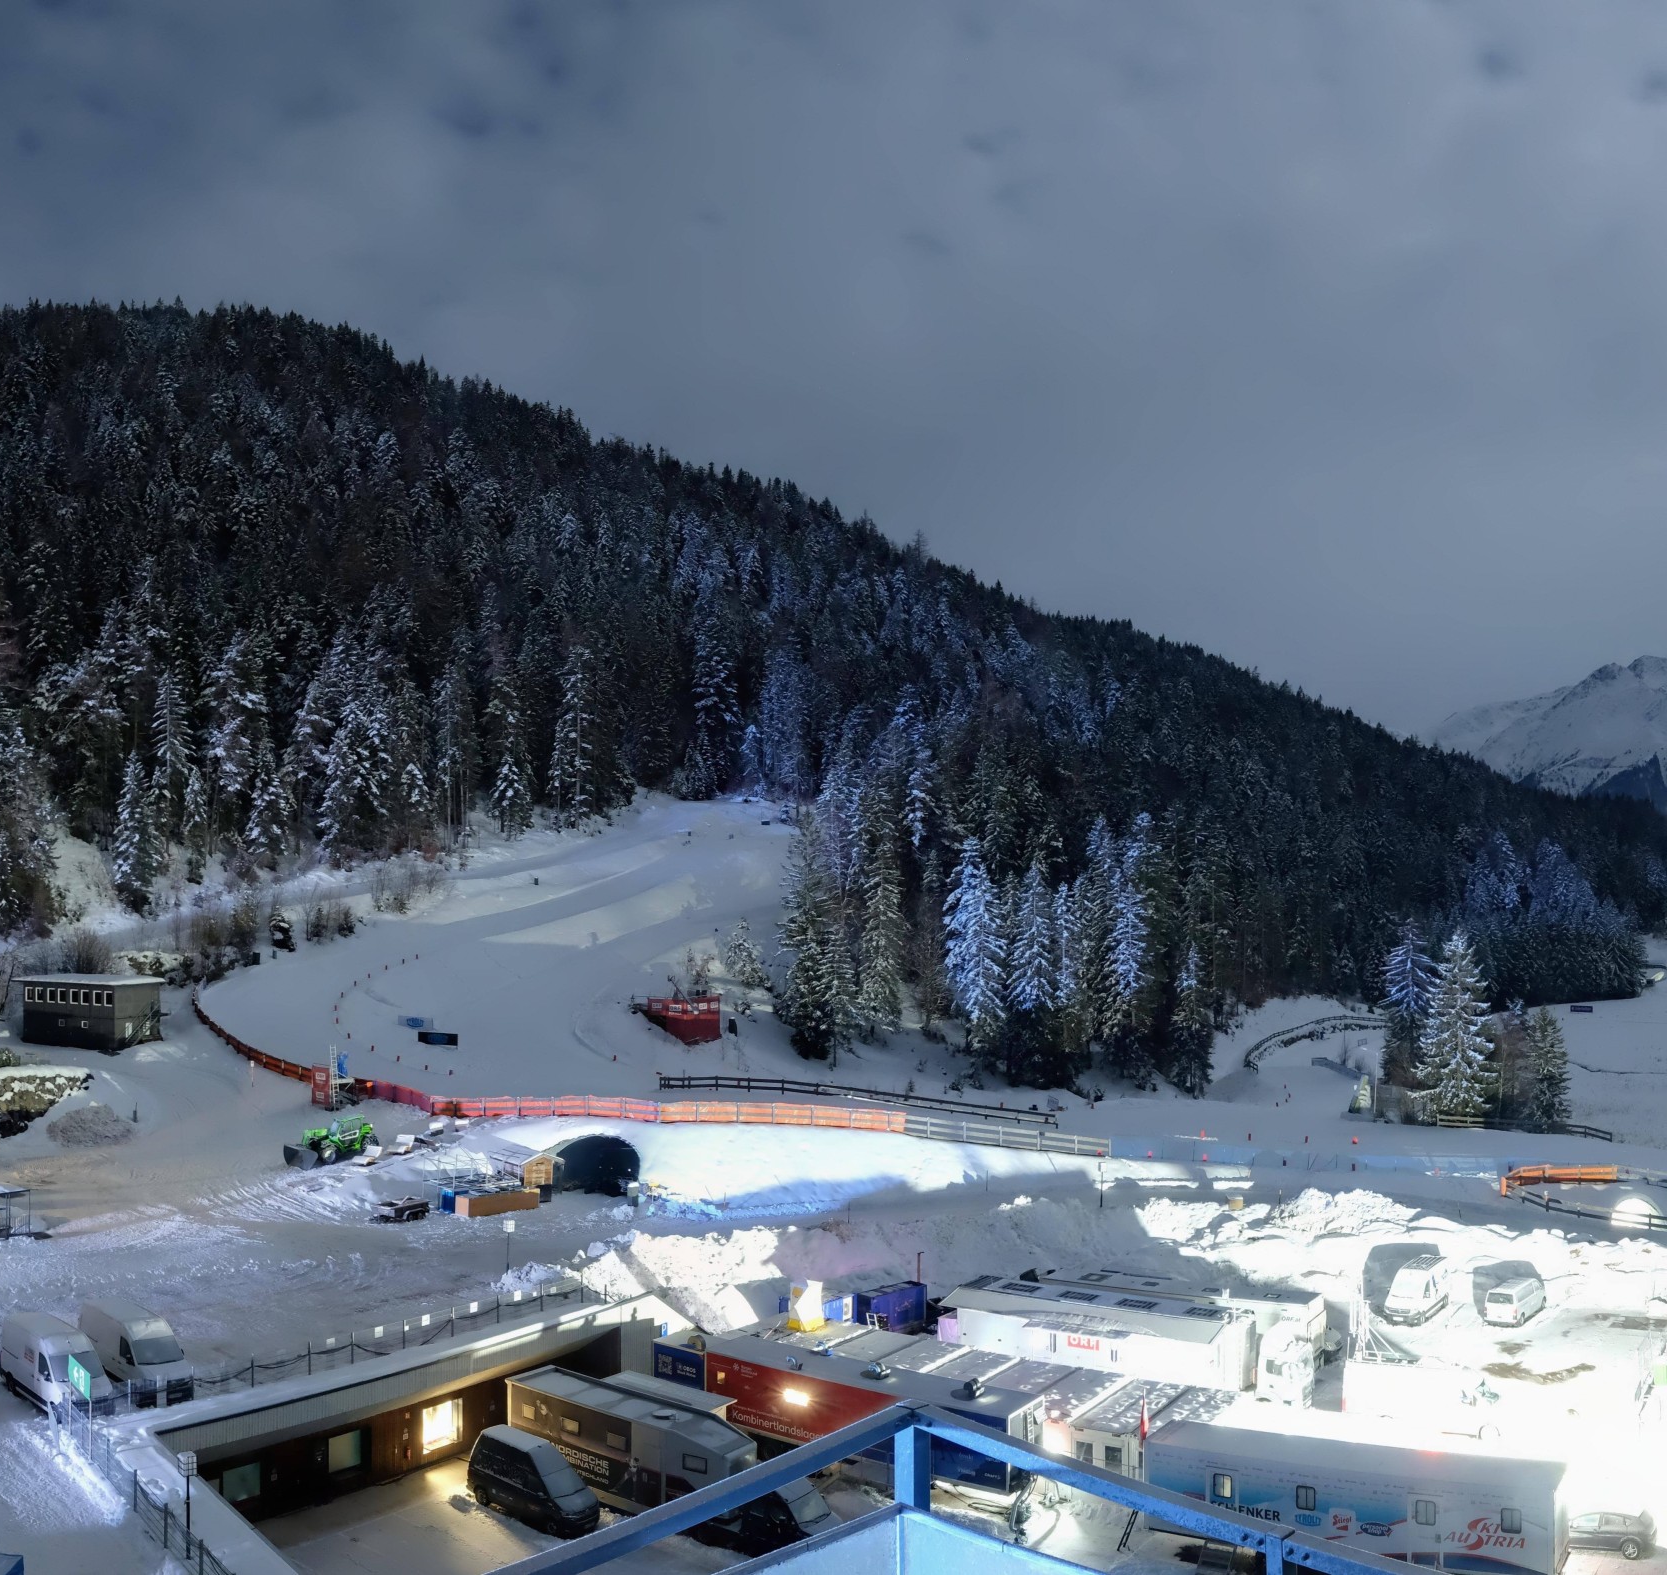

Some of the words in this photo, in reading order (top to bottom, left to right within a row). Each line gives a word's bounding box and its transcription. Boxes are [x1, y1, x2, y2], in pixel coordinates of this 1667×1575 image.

[562, 1453, 610, 1476] MBINATION
[1295, 1514, 1321, 1527] TYROLIT
[1333, 1514, 1352, 1527] Stiegl
[1362, 1523, 1388, 1532] personal
